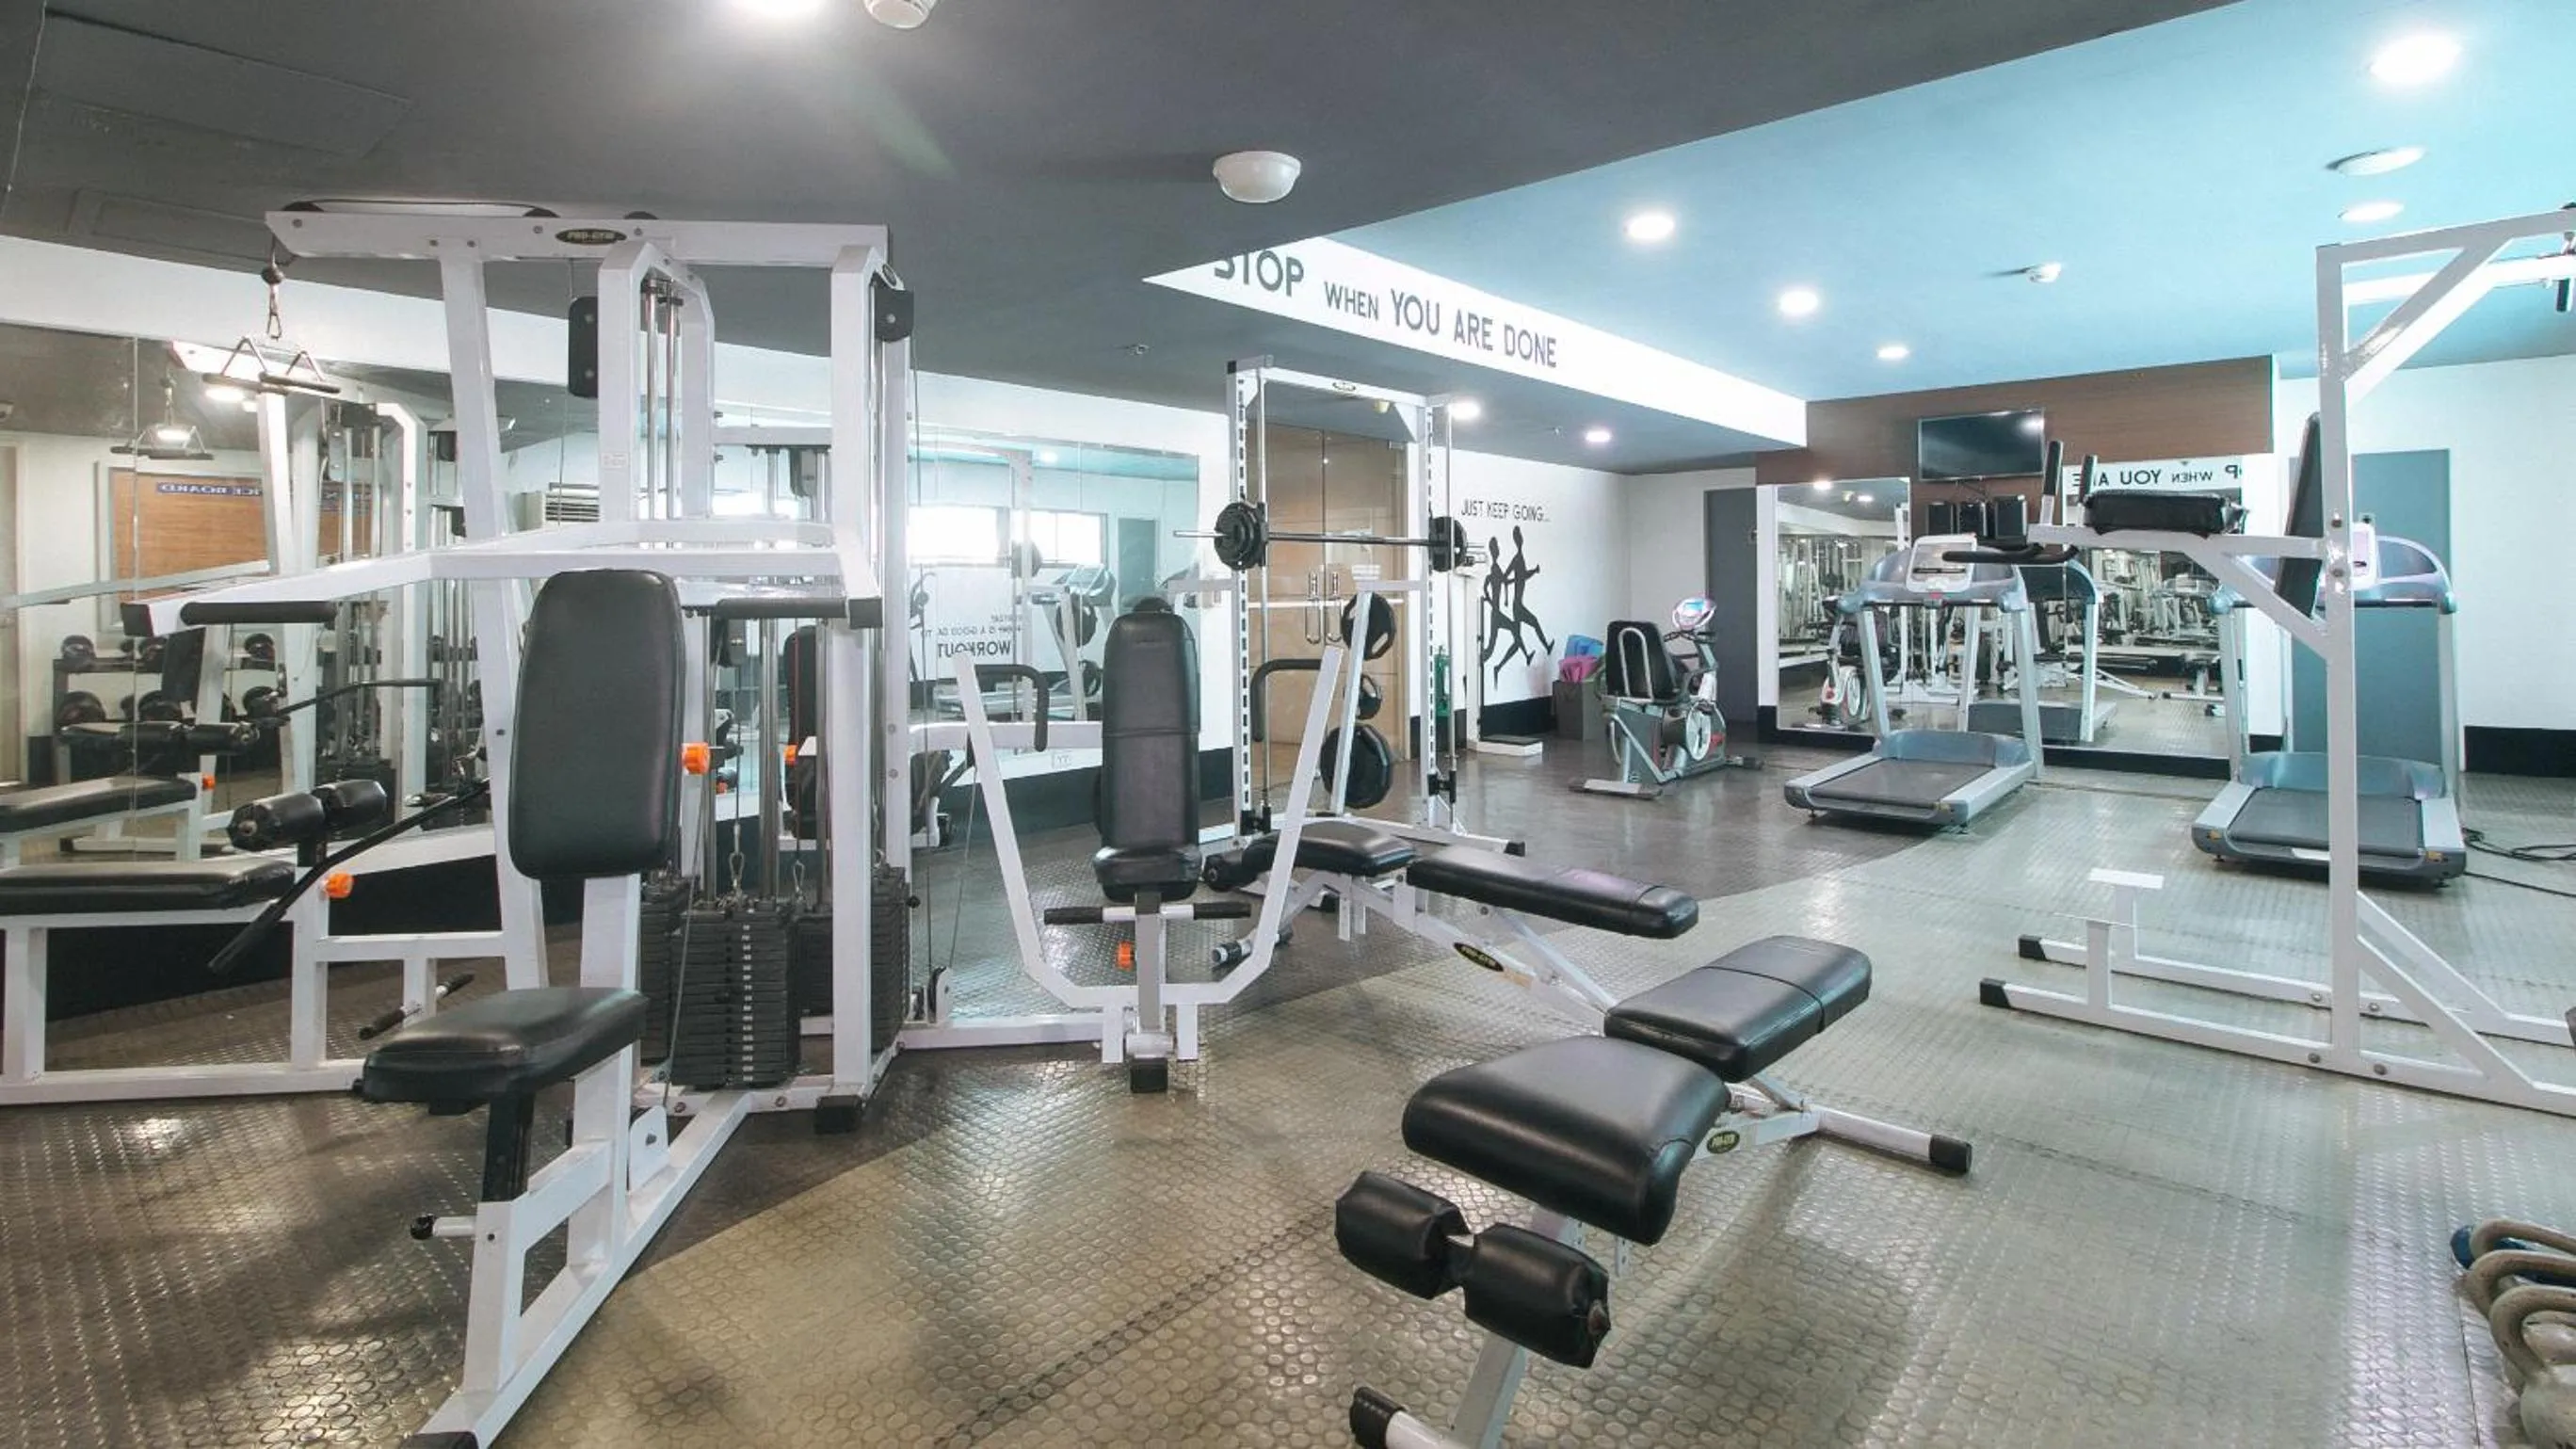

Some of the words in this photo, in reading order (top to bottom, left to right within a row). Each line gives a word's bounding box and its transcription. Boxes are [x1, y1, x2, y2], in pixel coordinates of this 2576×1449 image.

[1324, 282, 1378, 320] WHEN
[1391, 288, 1440, 335] YOU
[1454, 309, 1493, 351] ARE
[1504, 322, 1556, 368] DONE
[1461, 499, 1484, 516] JUST
[1487, 501, 1508, 519] KEEP
